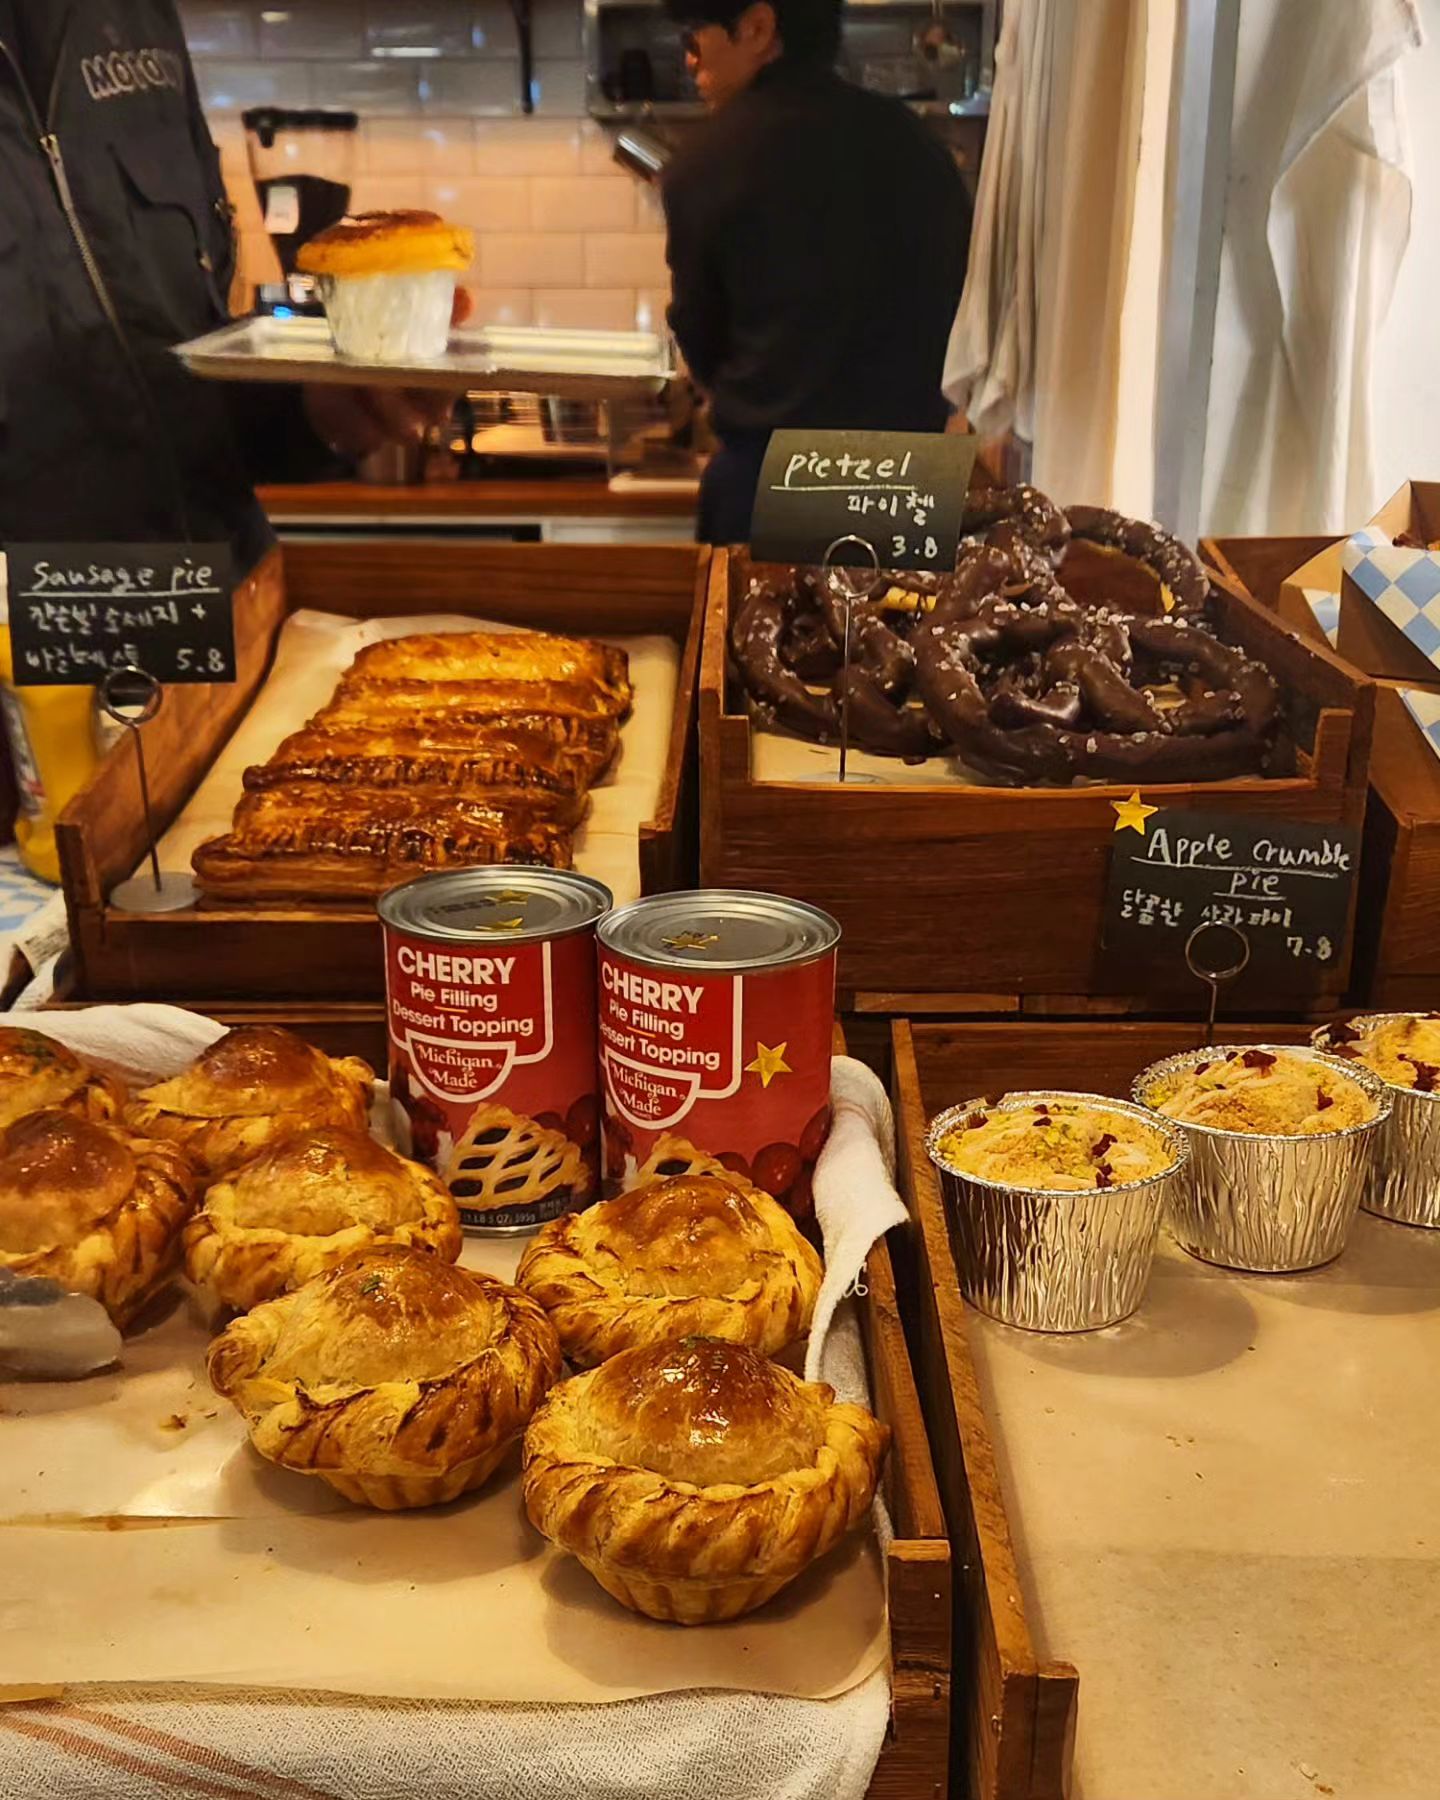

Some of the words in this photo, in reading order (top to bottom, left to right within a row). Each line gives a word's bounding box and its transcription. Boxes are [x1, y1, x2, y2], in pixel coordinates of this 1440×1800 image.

[891, 535, 938, 558] 3.8
[32, 561, 154, 596] Sausage
[171, 557, 213, 592] pie
[176, 648, 226, 673] 5.8
[1148, 828, 1233, 867] Apple
[1252, 839, 1351, 871] Crumble
[1120, 888, 1184, 927] 달콤한
[397, 945, 516, 985] CHERRY
[410, 981, 435, 1003] Pie
[440, 988, 498, 1012] Filling
[601, 960, 705, 1014] CHERRY
[392, 998, 445, 1030] Dessert
[449, 1015, 534, 1037] Topping
[609, 998, 628, 1022] Pie
[632, 1008, 685, 1041] Filling
[415, 1043, 493, 1072] Michigan
[599, 1023, 636, 1052] essert
[638, 1037, 720, 1071] Topping
[429, 1067, 479, 1089] Made
[611, 1061, 678, 1097] Michigan
[620, 1088, 662, 1116] Made
